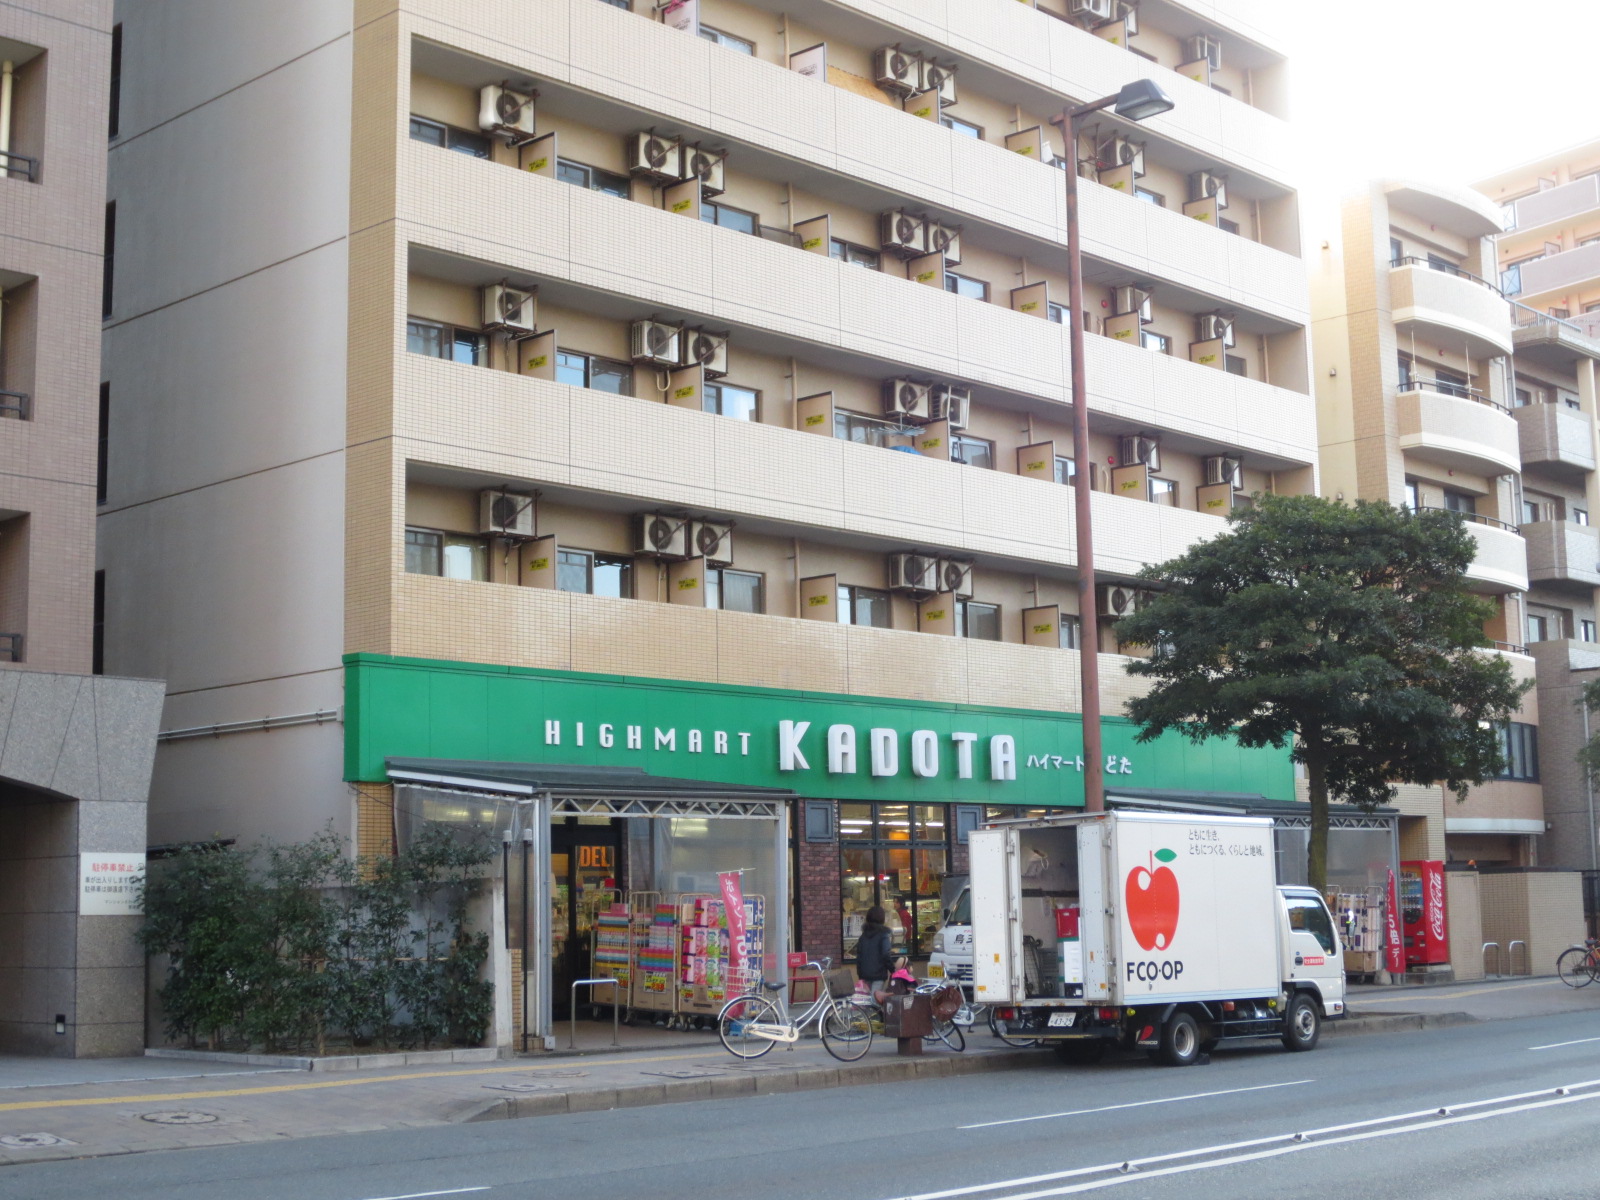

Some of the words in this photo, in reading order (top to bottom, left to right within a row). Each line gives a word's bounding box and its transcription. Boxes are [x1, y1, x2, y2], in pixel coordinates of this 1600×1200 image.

[544, 719, 752, 756] HIGHMART
[779, 718, 1017, 782] KADOTA
[92, 863, 134, 872] 駐停車禁止
